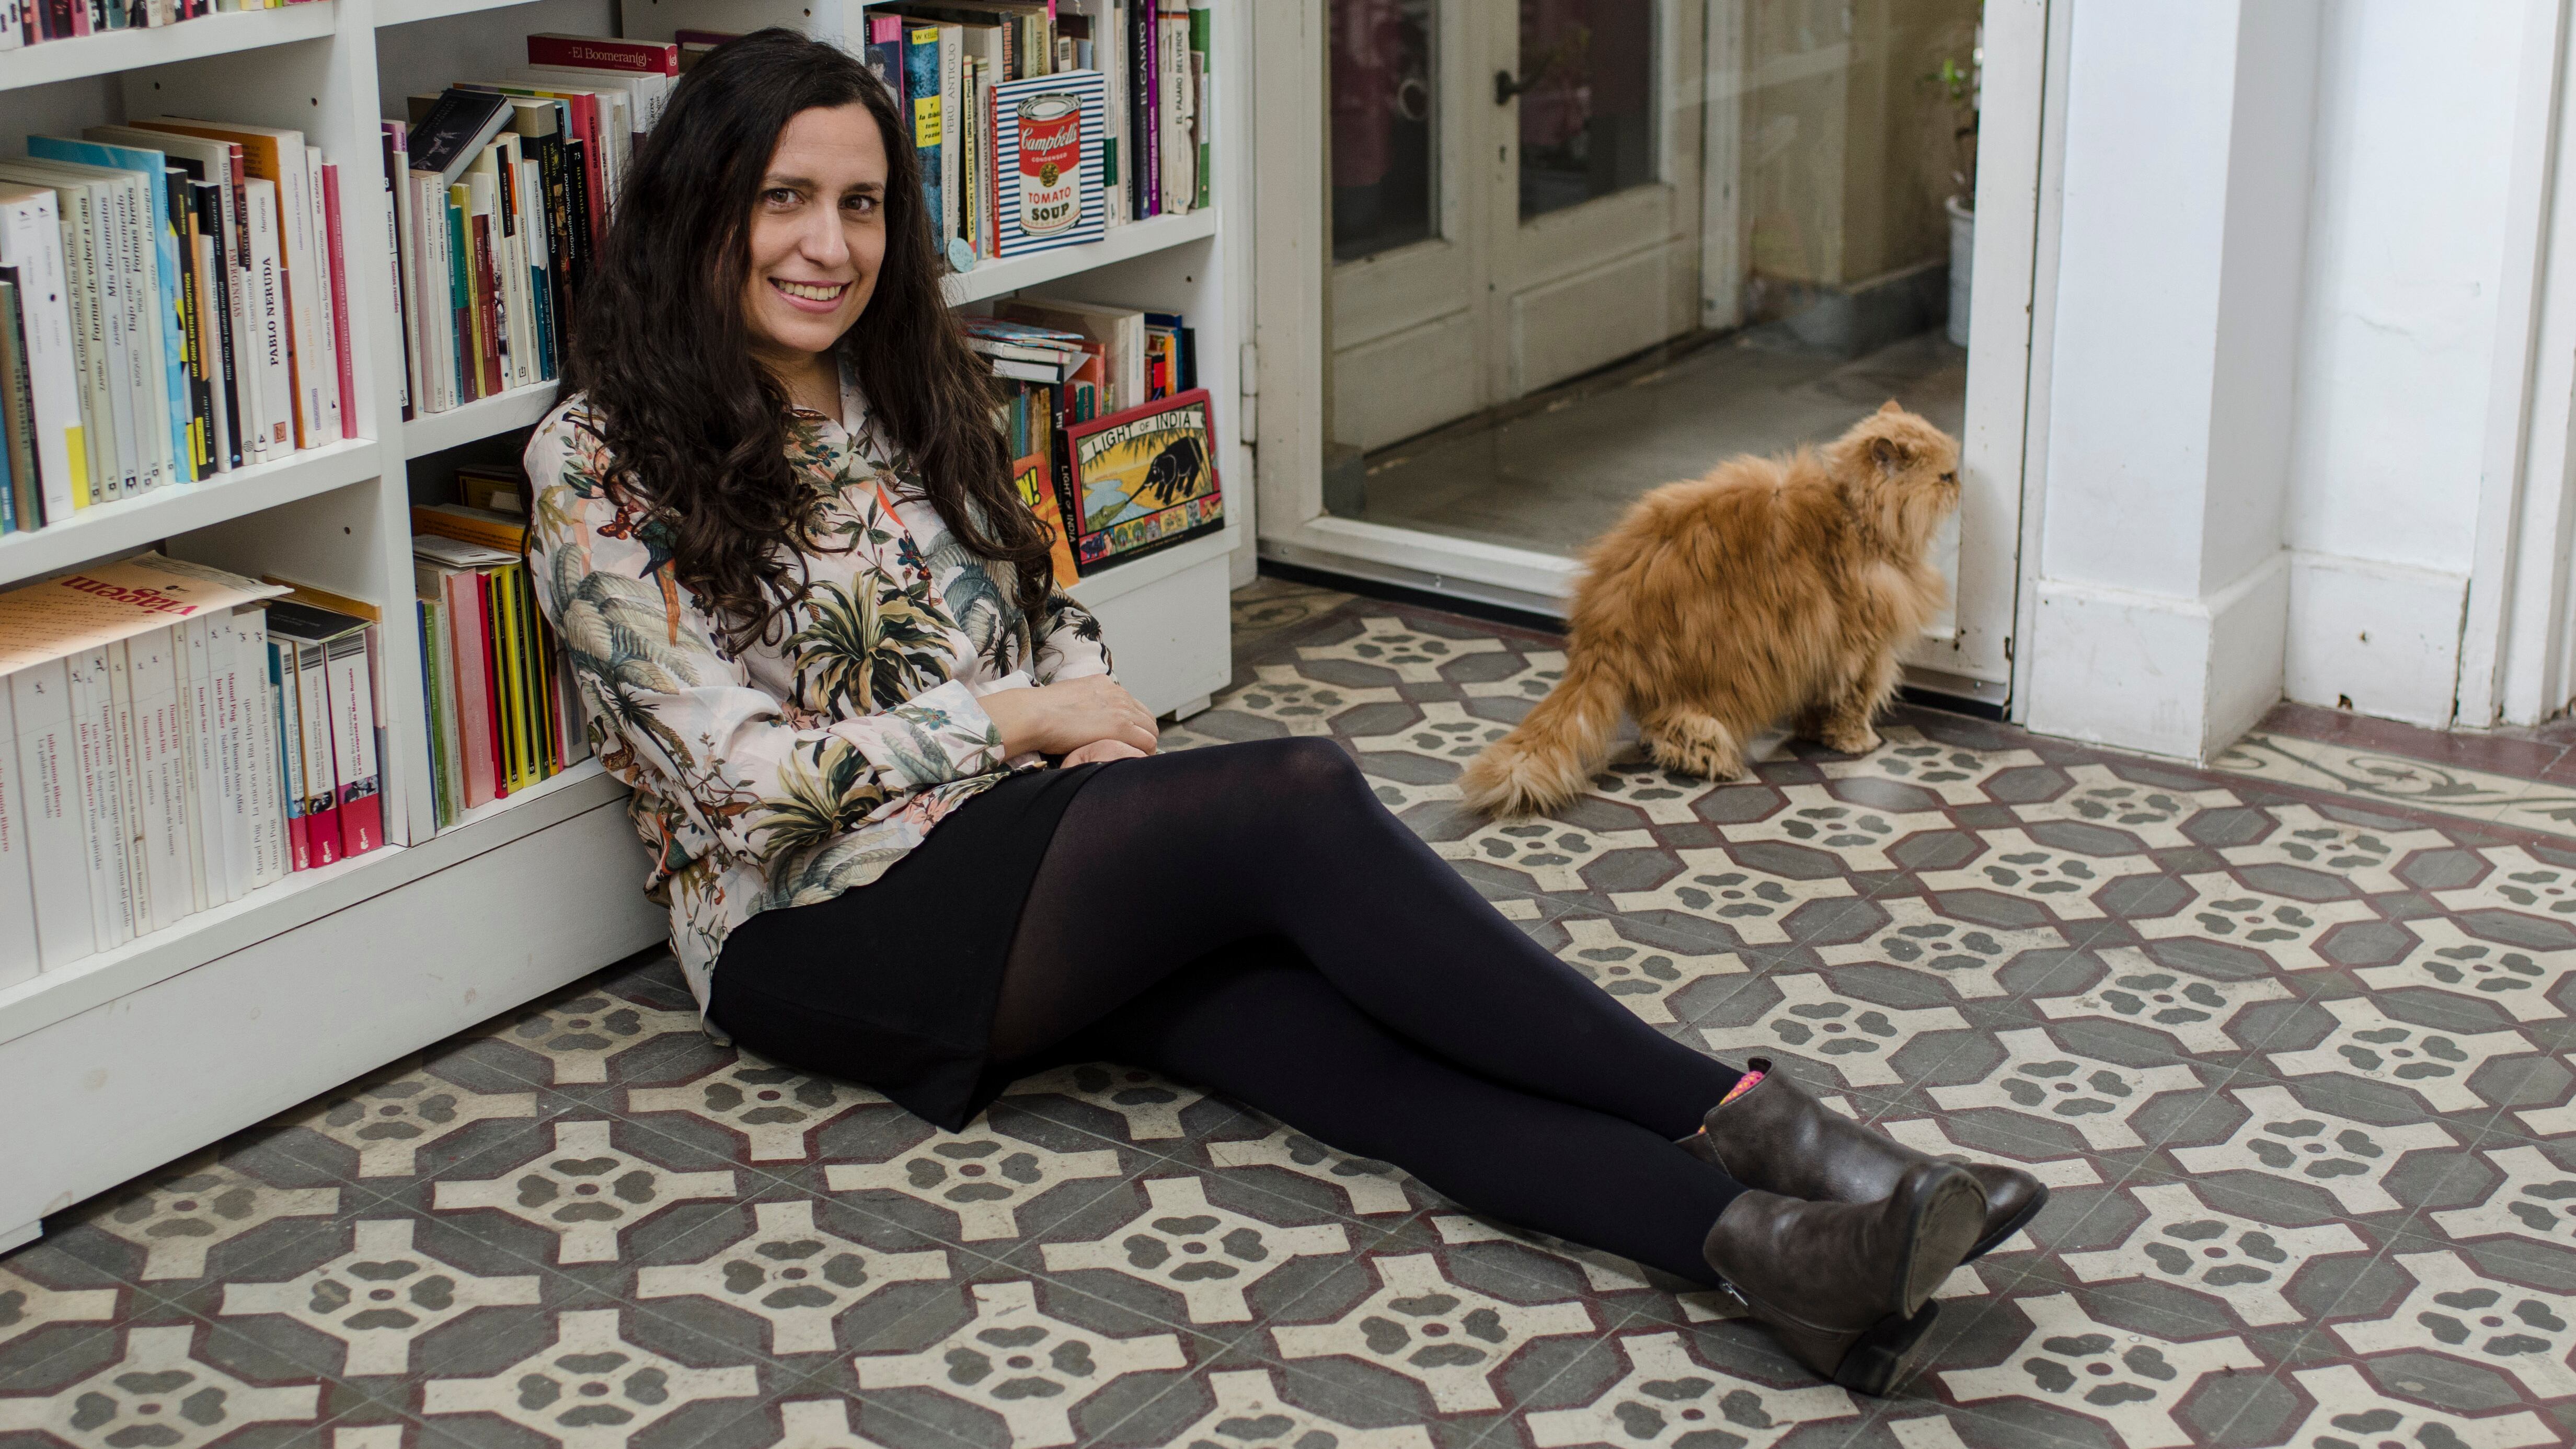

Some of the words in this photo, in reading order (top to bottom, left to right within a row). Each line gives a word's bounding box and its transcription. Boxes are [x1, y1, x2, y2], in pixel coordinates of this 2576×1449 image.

[573, 47, 582, 59] El
[586, 49, 647, 67] Boomeran(g)
[1003, 21, 1012, 64] Esperanza
[1004, 65, 1012, 74] la
[1141, 87, 1147, 105] EL
[946, 105, 954, 134] PERÚ
[1176, 114, 1182, 125] EL
[1032, 152, 1067, 162] CONDENSED
[127, 188, 137, 225] breves
[143, 188, 152, 213] negra
[1028, 187, 1071, 204] TOMATO
[79, 198, 88, 225] casa
[117, 195, 129, 252] tremendo
[1032, 203, 1070, 221] SOUP
[100, 197, 114, 271] documentos
[146, 232, 154, 242] La
[67, 233, 77, 267] árboles
[84, 239, 94, 275] volver
[131, 230, 142, 273] Formas
[122, 257, 131, 274] sol
[71, 288, 78, 298] de
[87, 279, 96, 293] de
[108, 275, 117, 297] Mis
[124, 278, 133, 302] este
[185, 272, 193, 313] NOSOTROS
[229, 249, 241, 317] EMERGENCIAS
[262, 257, 275, 316] NERUDA
[74, 302, 84, 335] privada
[91, 297, 100, 341] Formas
[112, 315, 121, 347] ZAMBRA
[126, 306, 137, 331] Bajo
[267, 321, 279, 366] PABLO
[79, 360, 86, 372] La
[133, 350, 142, 387] BUSQUED
[1092, 424, 1134, 455] LIGHT
[1140, 421, 1150, 432] OF
[1156, 411, 1191, 429] INDIA
[1061, 465, 1071, 497] LIGHT
[1065, 500, 1071, 510] OF
[1067, 514, 1076, 543] INDIA
[61, 576, 199, 617] viagem
[231, 727, 239, 741] The
[243, 699, 254, 740] Hayworth
[38, 739, 45, 748] La
[47, 734, 56, 753] Julio
[38, 751, 48, 779] palabra
[50, 755, 58, 784] Ramón
[249, 761, 256, 771] de
[54, 786, 63, 817] Ribeyro
[249, 774, 258, 804] traición
[83, 744, 91, 773] Ramón
[91, 835, 102, 870] apátridas
[252, 807, 259, 816] La
[253, 824, 261, 842] Puig
[254, 846, 263, 876] Manuel
